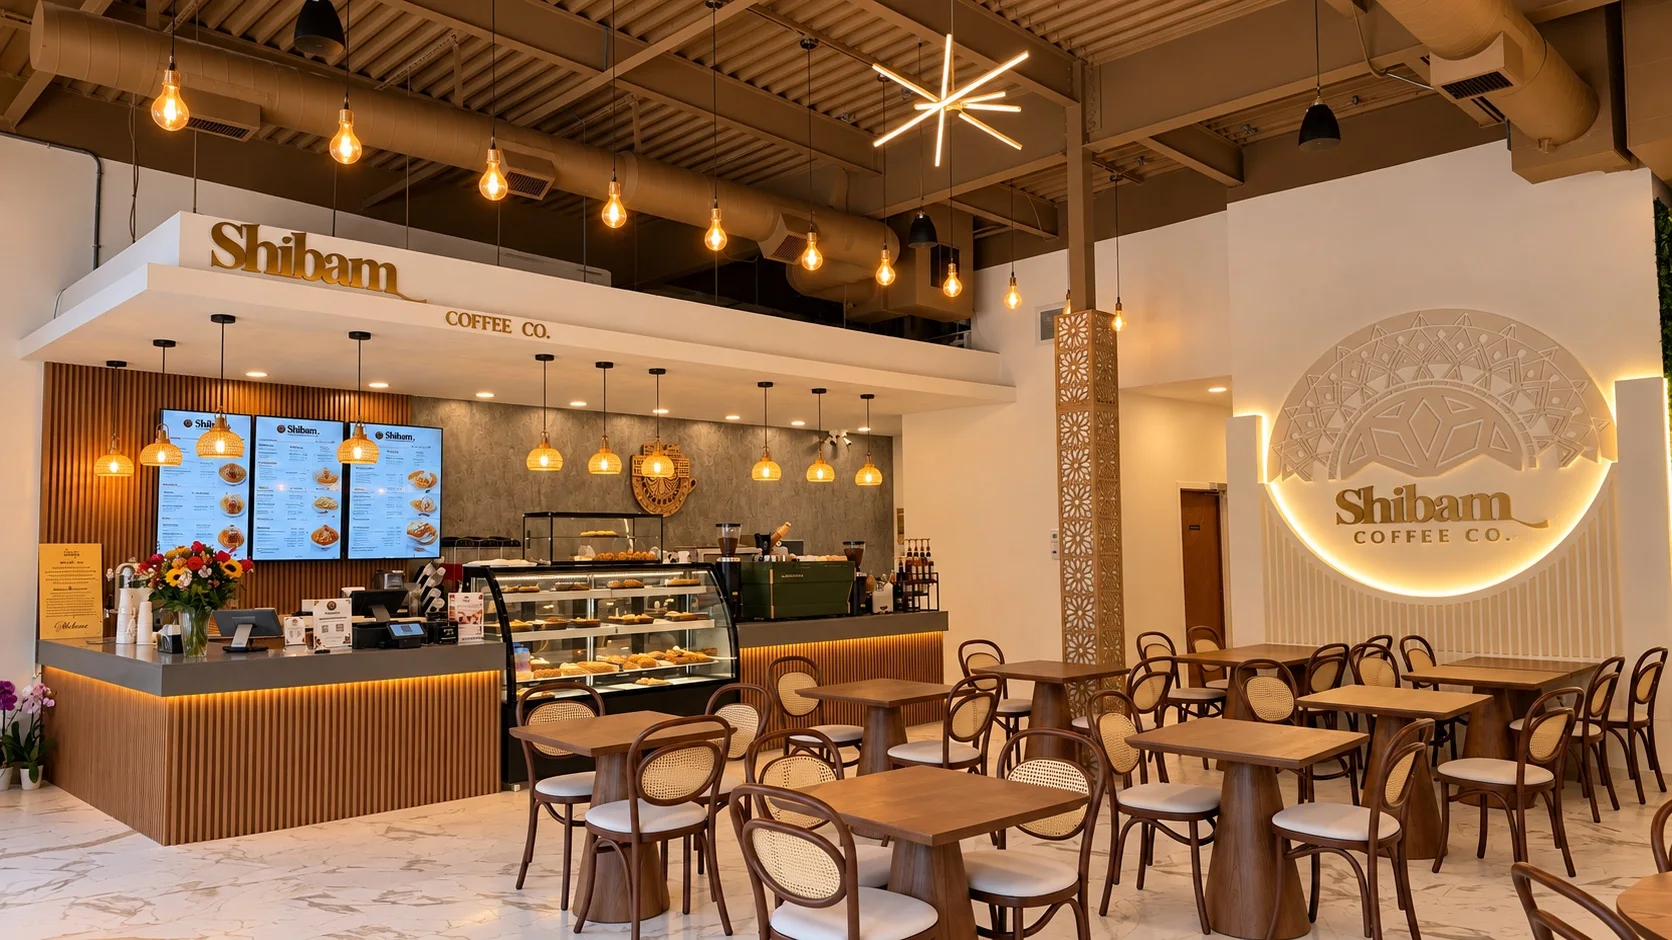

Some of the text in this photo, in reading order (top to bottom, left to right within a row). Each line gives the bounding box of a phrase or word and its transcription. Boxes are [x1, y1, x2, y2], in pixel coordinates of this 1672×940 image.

[210, 221, 427, 303] Shibam
[445, 310, 551, 339] COFFEE CO.
[1335, 483, 1549, 529] Shibam
[1354, 528, 1511, 544] COFFEE CO.
